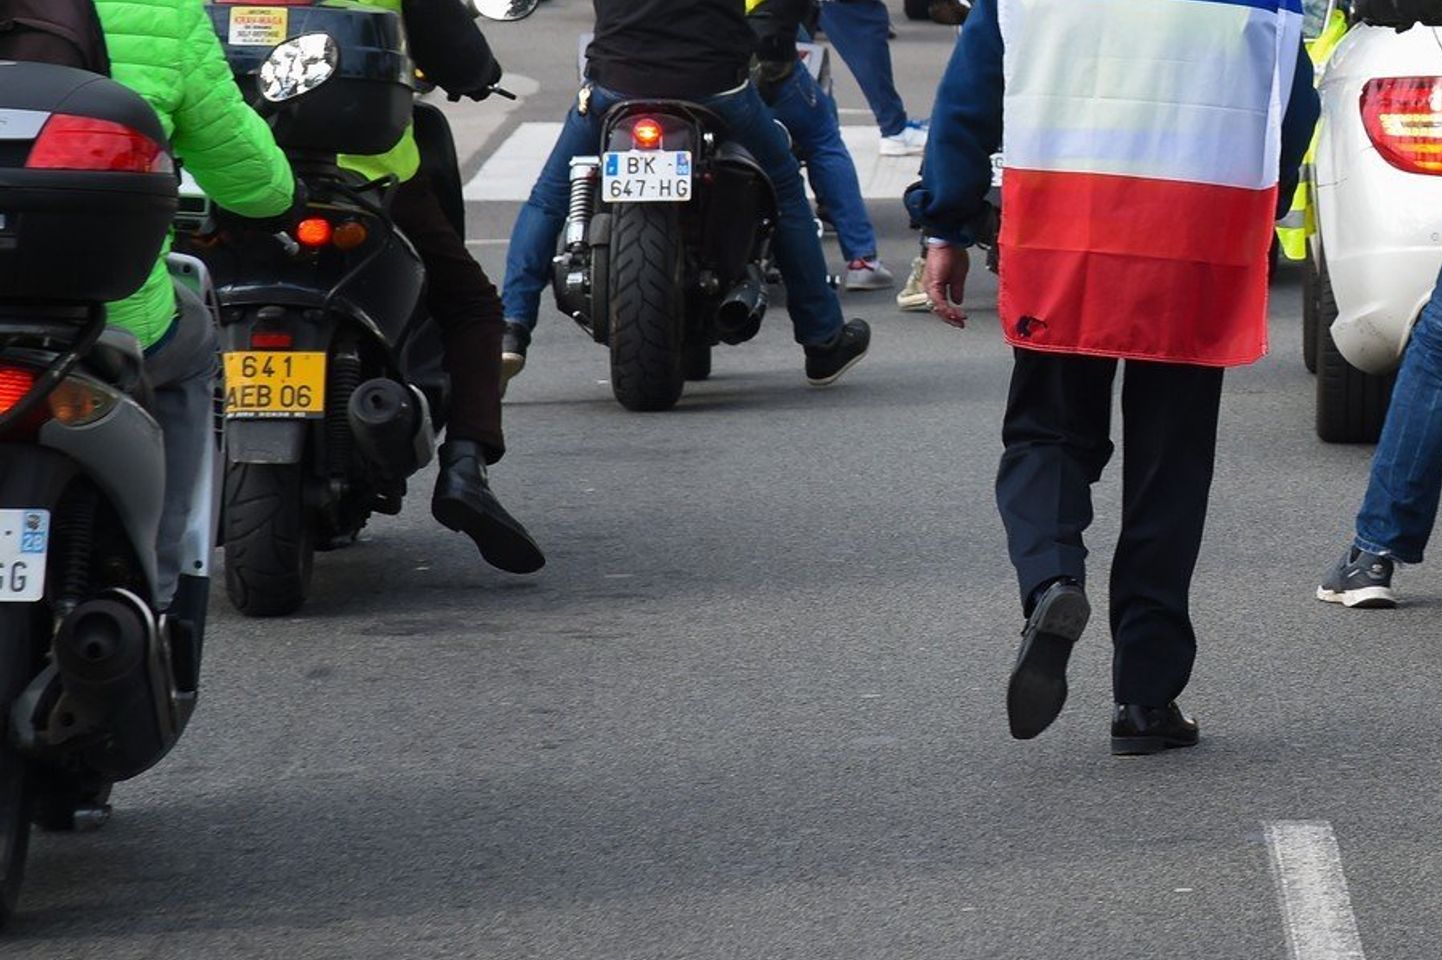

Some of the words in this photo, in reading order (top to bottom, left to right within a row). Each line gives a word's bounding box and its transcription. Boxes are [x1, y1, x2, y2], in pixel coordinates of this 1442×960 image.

[610, 179, 688, 197] 647-HG
[242, 355, 292, 378] 641
[226, 385, 272, 408] AEB
[280, 385, 312, 408] 06
[0, 561, 27, 593] G
